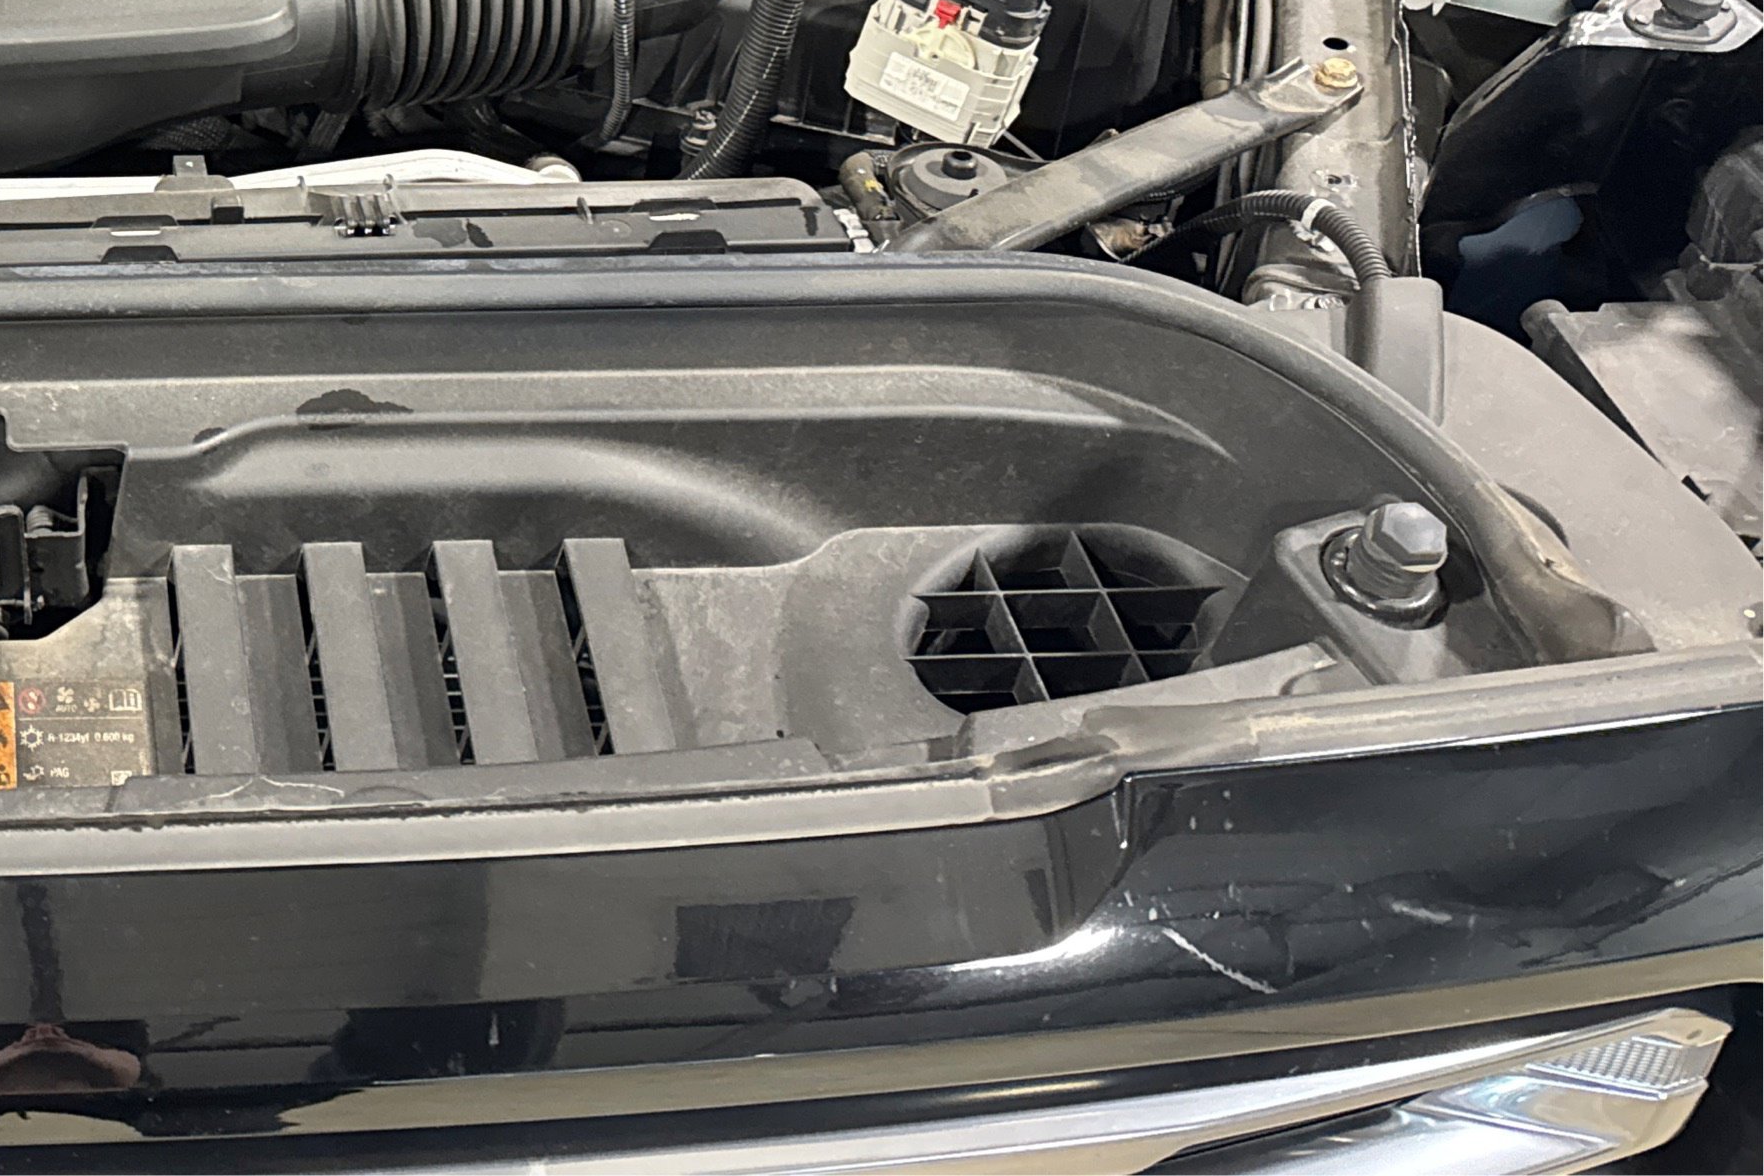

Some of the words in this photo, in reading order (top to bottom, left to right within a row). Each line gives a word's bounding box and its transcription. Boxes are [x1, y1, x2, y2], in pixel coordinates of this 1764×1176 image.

[55, 704, 78, 713] AUTO
[122, 732, 135, 744] kg
[50, 767, 70, 778] PAG
